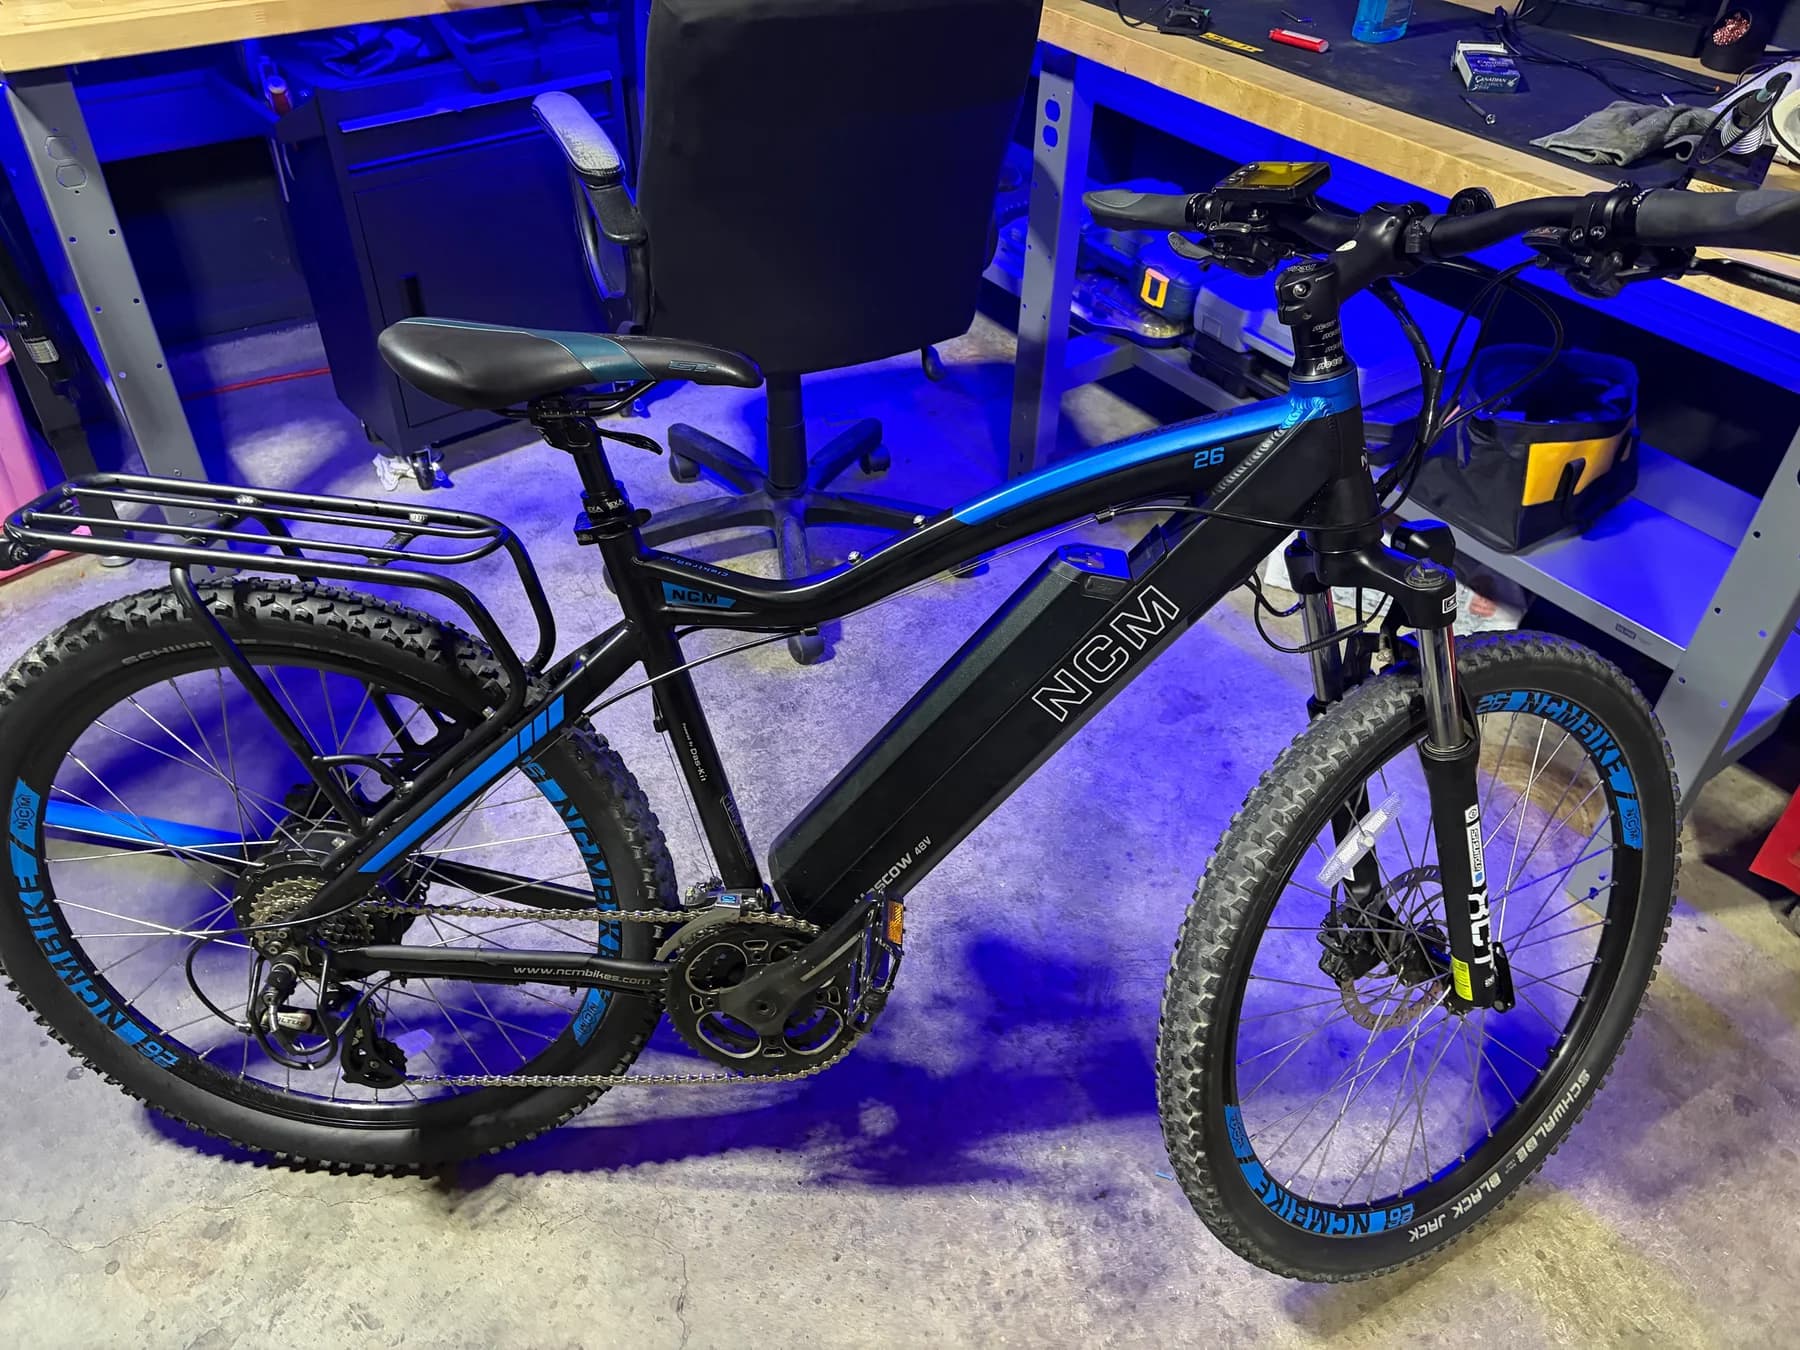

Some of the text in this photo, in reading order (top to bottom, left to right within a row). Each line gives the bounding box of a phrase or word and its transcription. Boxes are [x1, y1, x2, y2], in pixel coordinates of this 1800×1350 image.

[1193, 446, 1225, 469] 26
[672, 589, 718, 605] NCM
[1032, 585, 1180, 722] NCM
[1518, 691, 1628, 781] NCMBIKE
[15, 795, 34, 831] NCM
[854, 836, 931, 904] SCOW 48V
[15, 872, 126, 1028] NCMBIKE
[513, 966, 651, 985] www.ncmbikes.com
[139, 1040, 180, 1068] 26
[1408, 1069, 1591, 1243] SCHWALBE BLACK JACK
[1254, 1175, 1370, 1236] NCMBIKE
[1388, 1202, 1416, 1229] 26
